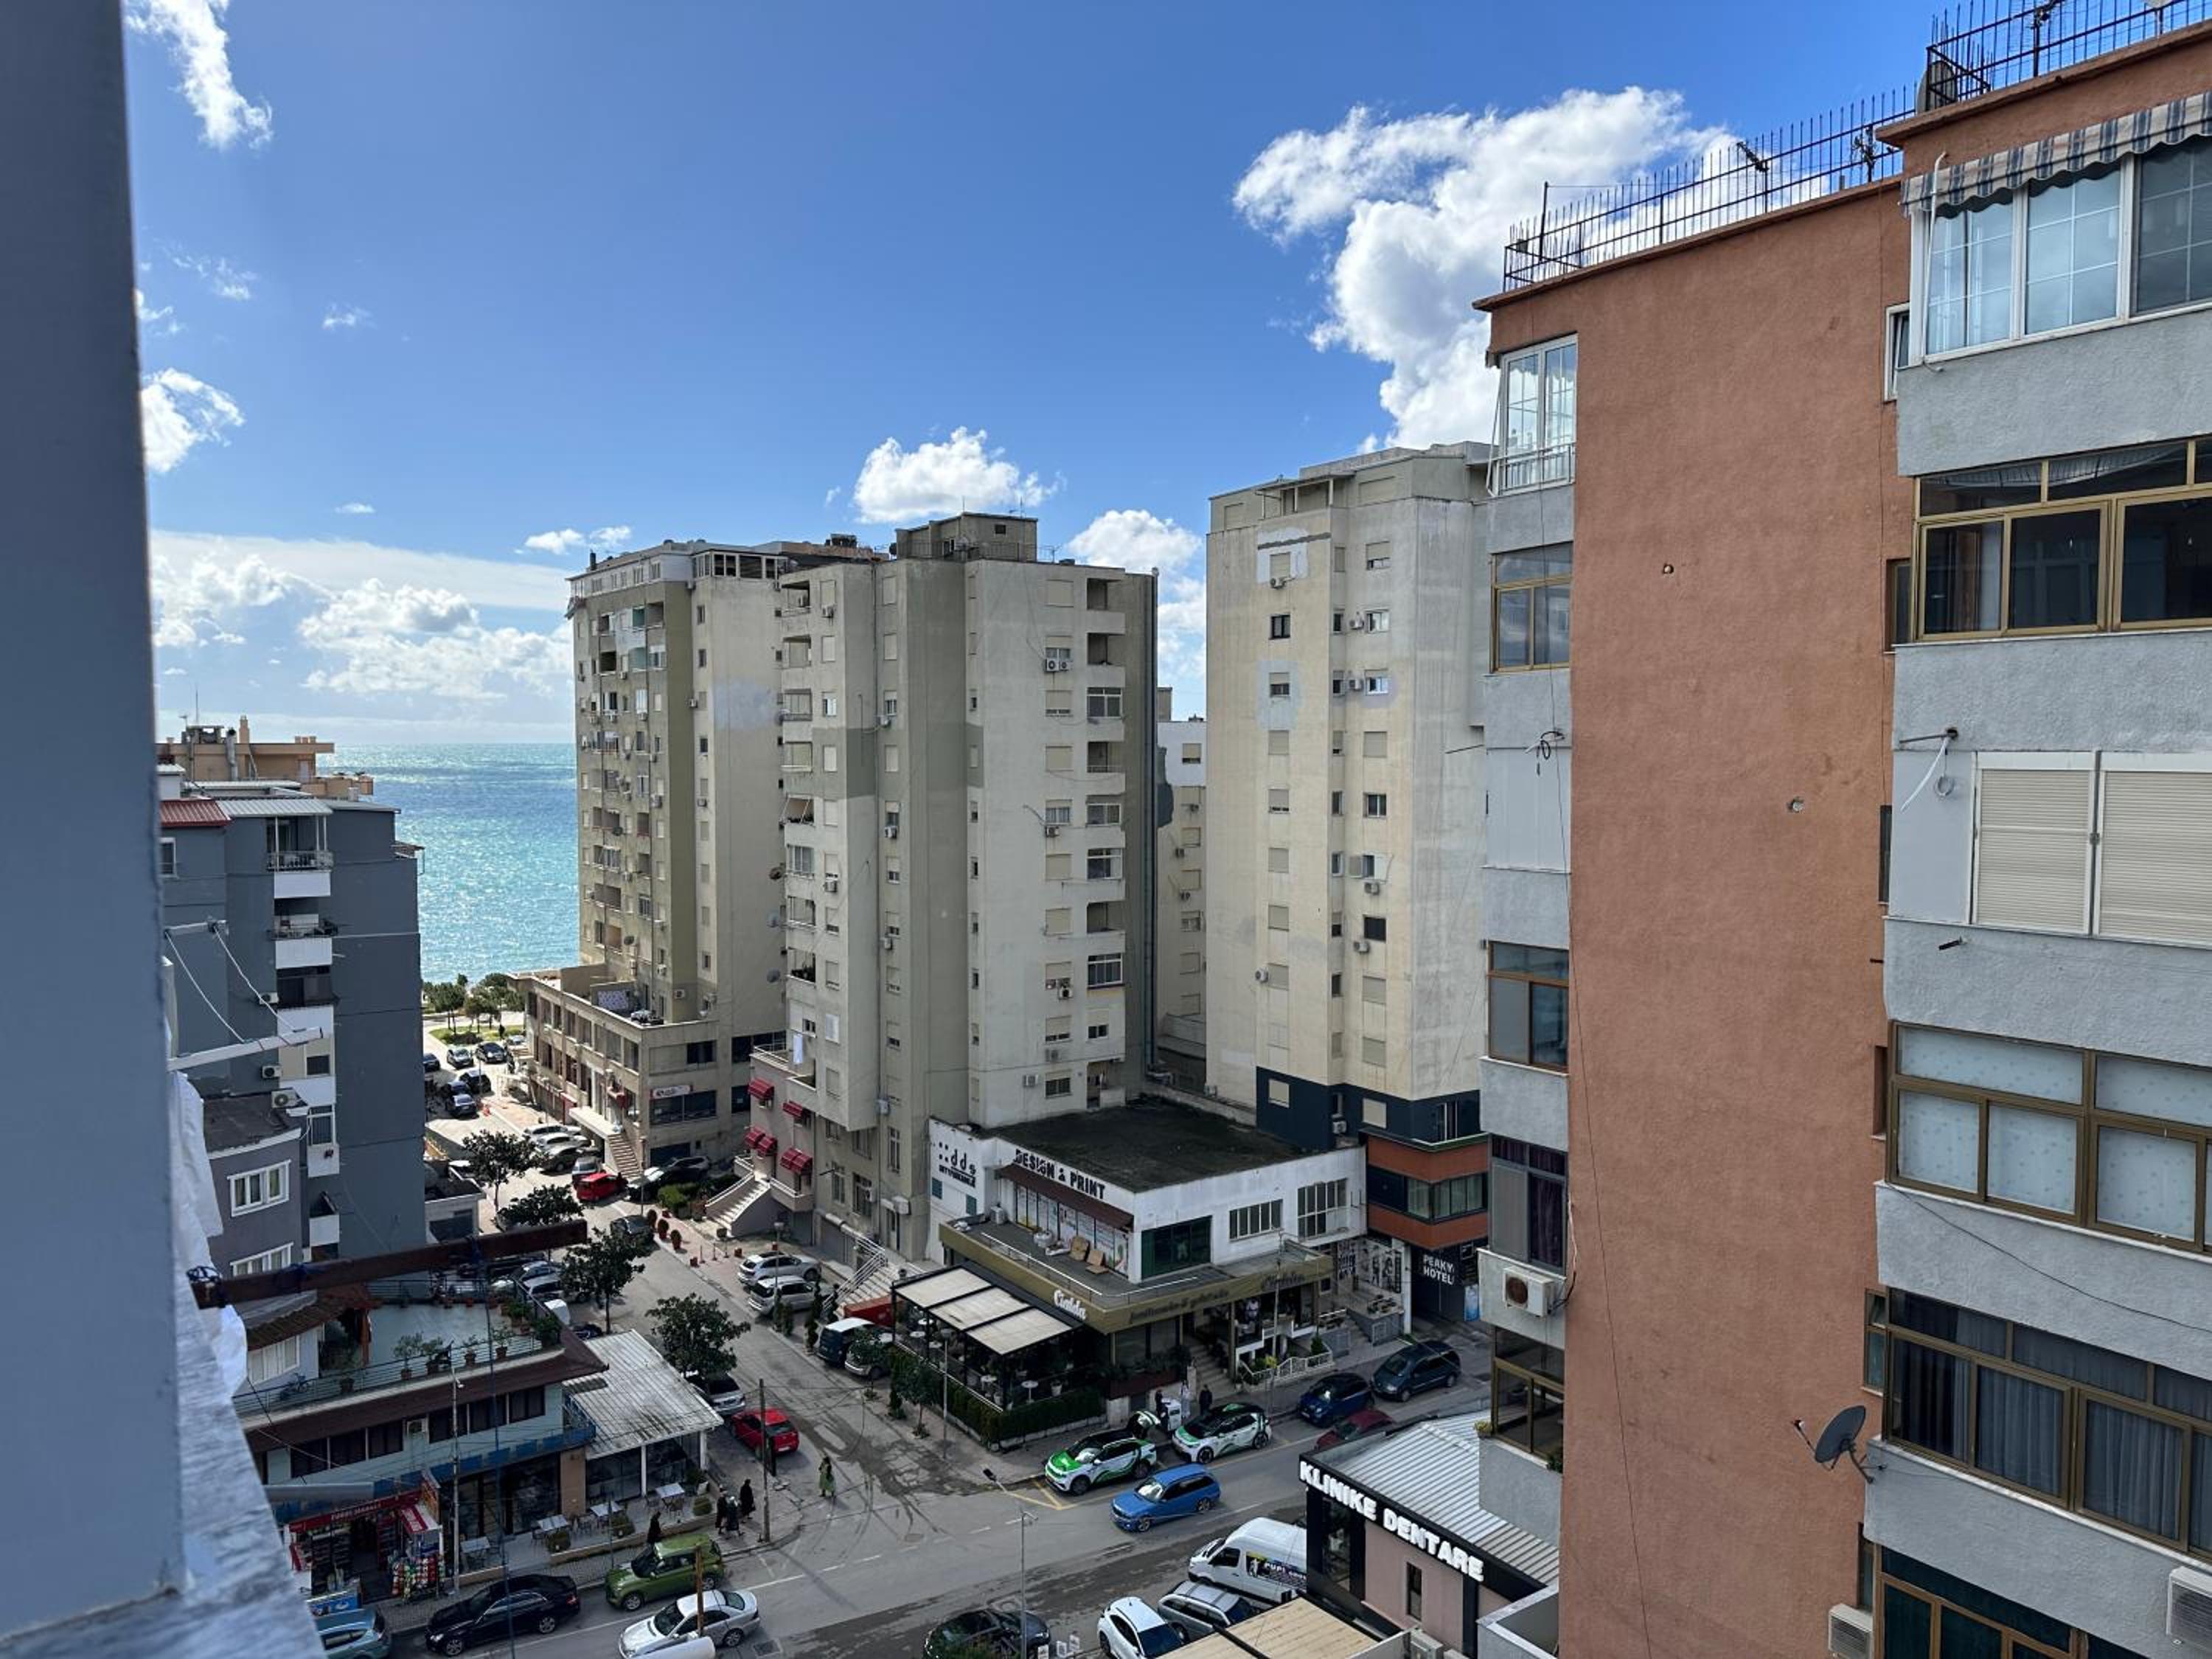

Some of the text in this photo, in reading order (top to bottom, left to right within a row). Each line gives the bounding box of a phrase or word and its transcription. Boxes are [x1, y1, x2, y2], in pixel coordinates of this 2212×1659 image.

[1013, 1148, 1106, 1200] DESIGN & PRINT
[1423, 1253, 1453, 1273] PEAKY
[1423, 1265, 1453, 1285] HOTEL
[1299, 1461, 1485, 1582] KLINIKE DENTARE
